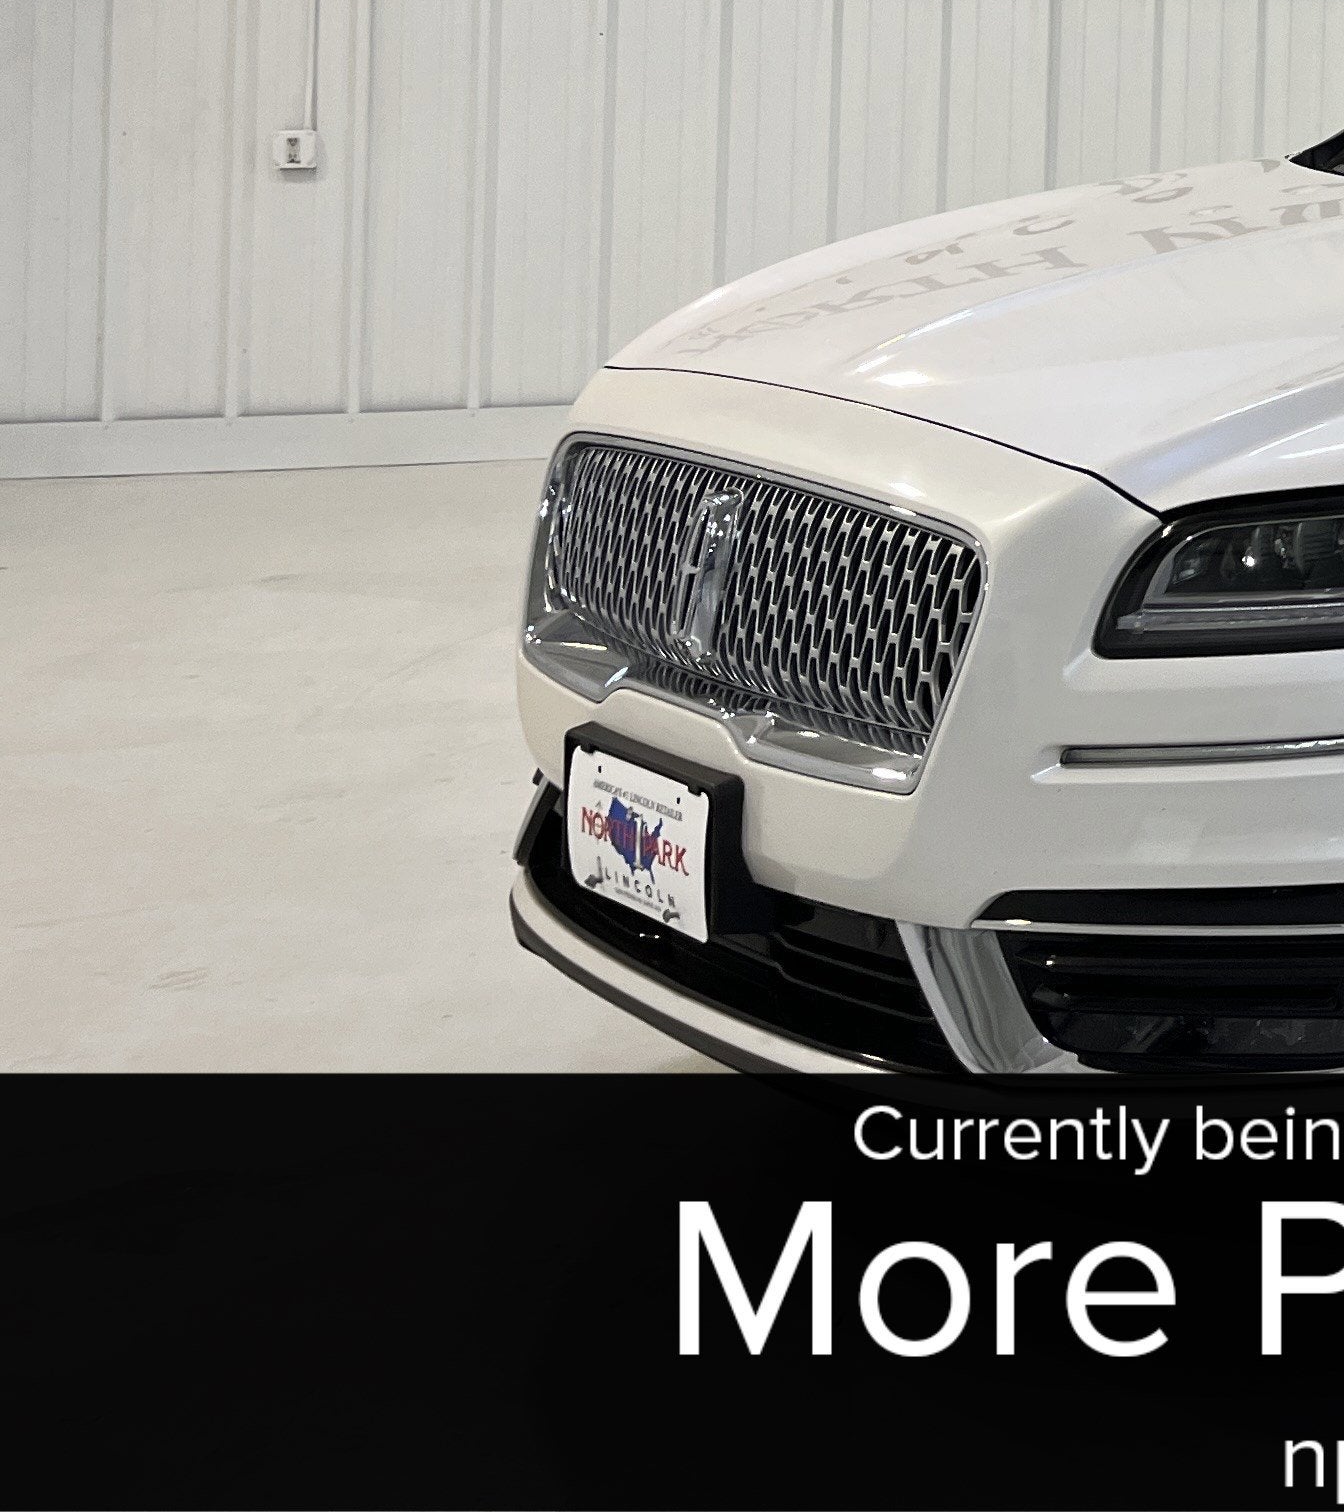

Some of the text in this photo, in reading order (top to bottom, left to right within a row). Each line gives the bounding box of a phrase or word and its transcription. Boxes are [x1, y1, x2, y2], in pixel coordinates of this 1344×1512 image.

[581, 806, 689, 876] NORTH PARK
[604, 866, 676, 908] LINCOLN
